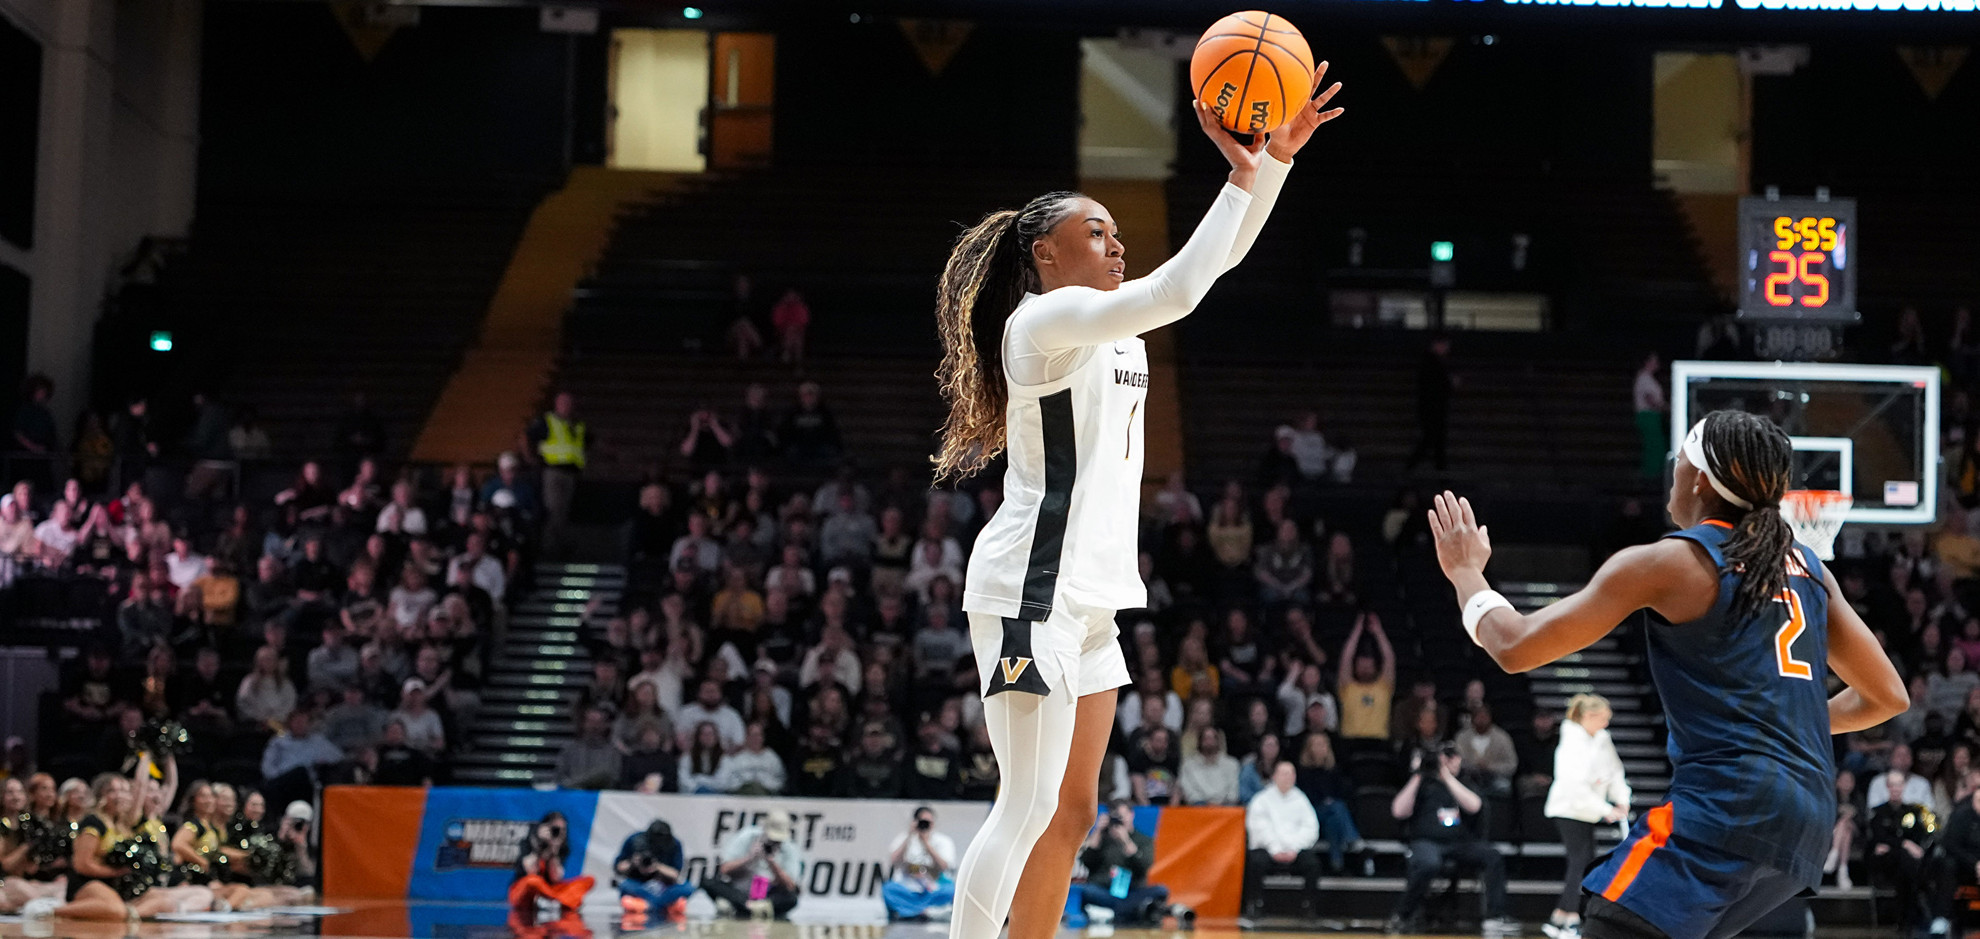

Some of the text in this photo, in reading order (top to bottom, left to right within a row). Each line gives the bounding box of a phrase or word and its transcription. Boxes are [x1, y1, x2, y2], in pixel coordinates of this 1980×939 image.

[1214, 82, 1238, 122] son
[1247, 101, 1270, 133] CAA
[1774, 216, 1838, 252] 5:55
[1764, 250, 1830, 308] 25
[1772, 587, 1814, 680] 2
[1000, 656, 1033, 685] V
